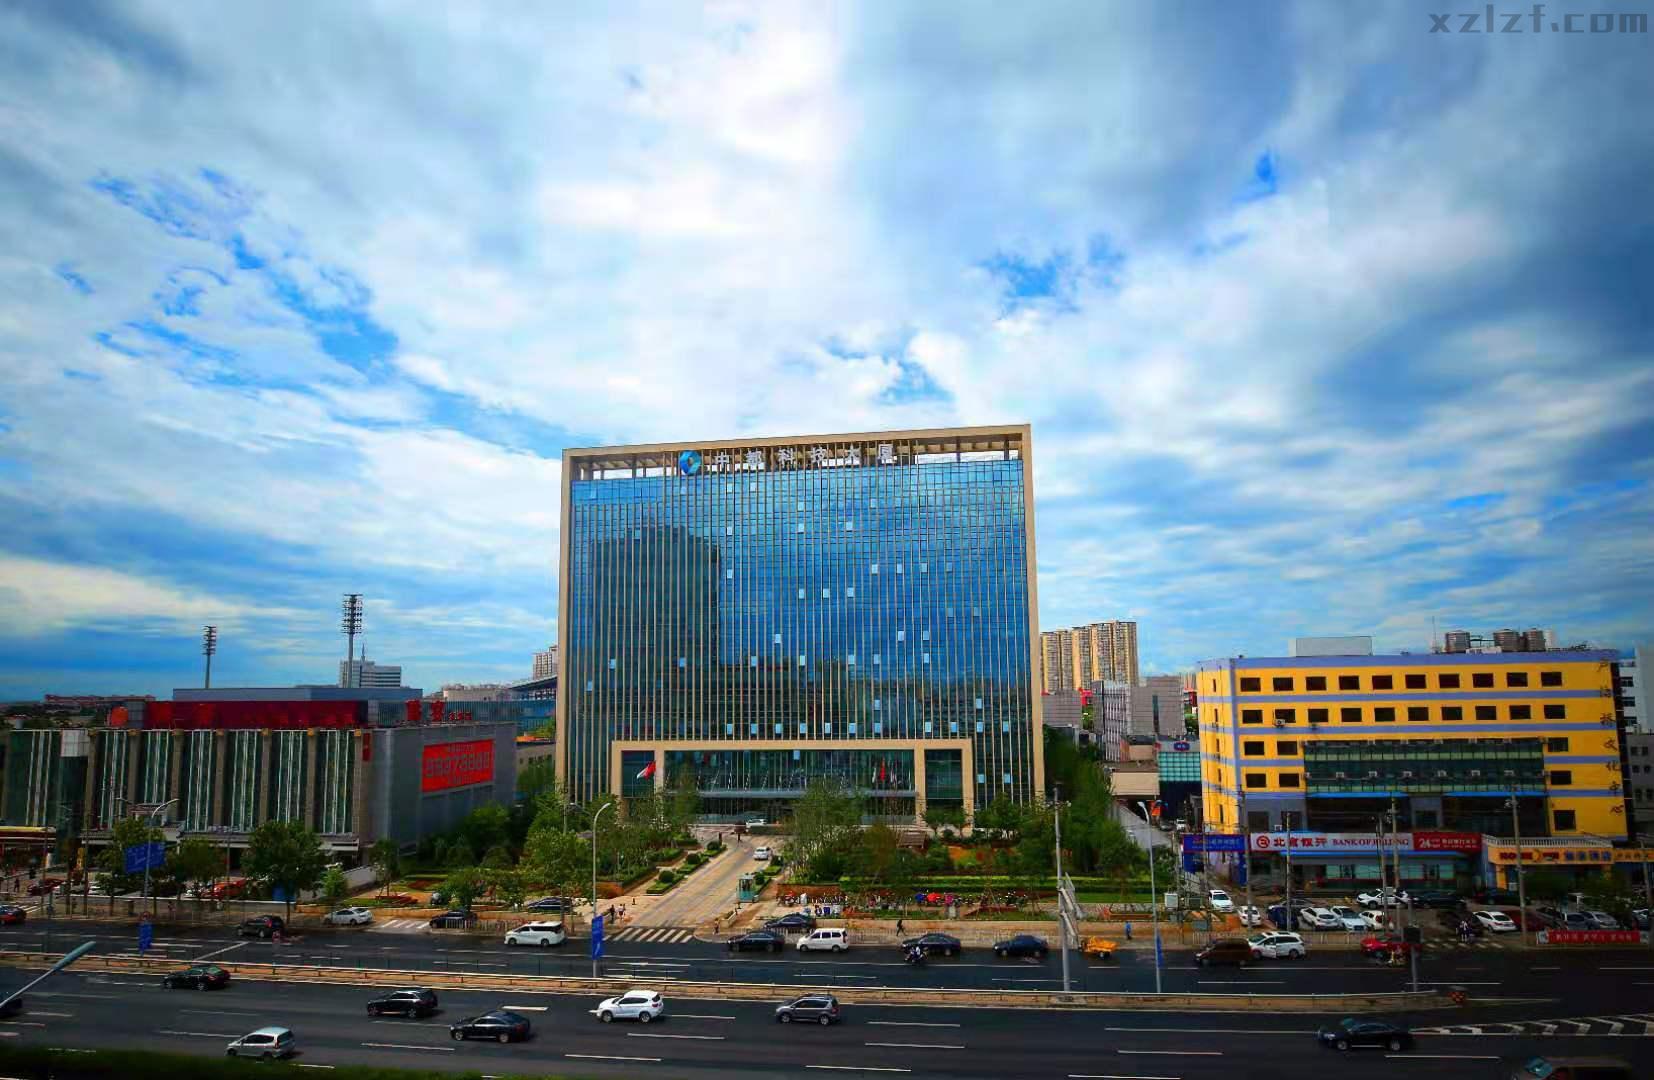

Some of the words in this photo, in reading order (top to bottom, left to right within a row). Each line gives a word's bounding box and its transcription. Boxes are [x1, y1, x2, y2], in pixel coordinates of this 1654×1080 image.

[714, 443, 894, 470] 中都科技大厦
[1273, 836, 1327, 848] 北京银行
[1332, 838, 1358, 846] BANK
